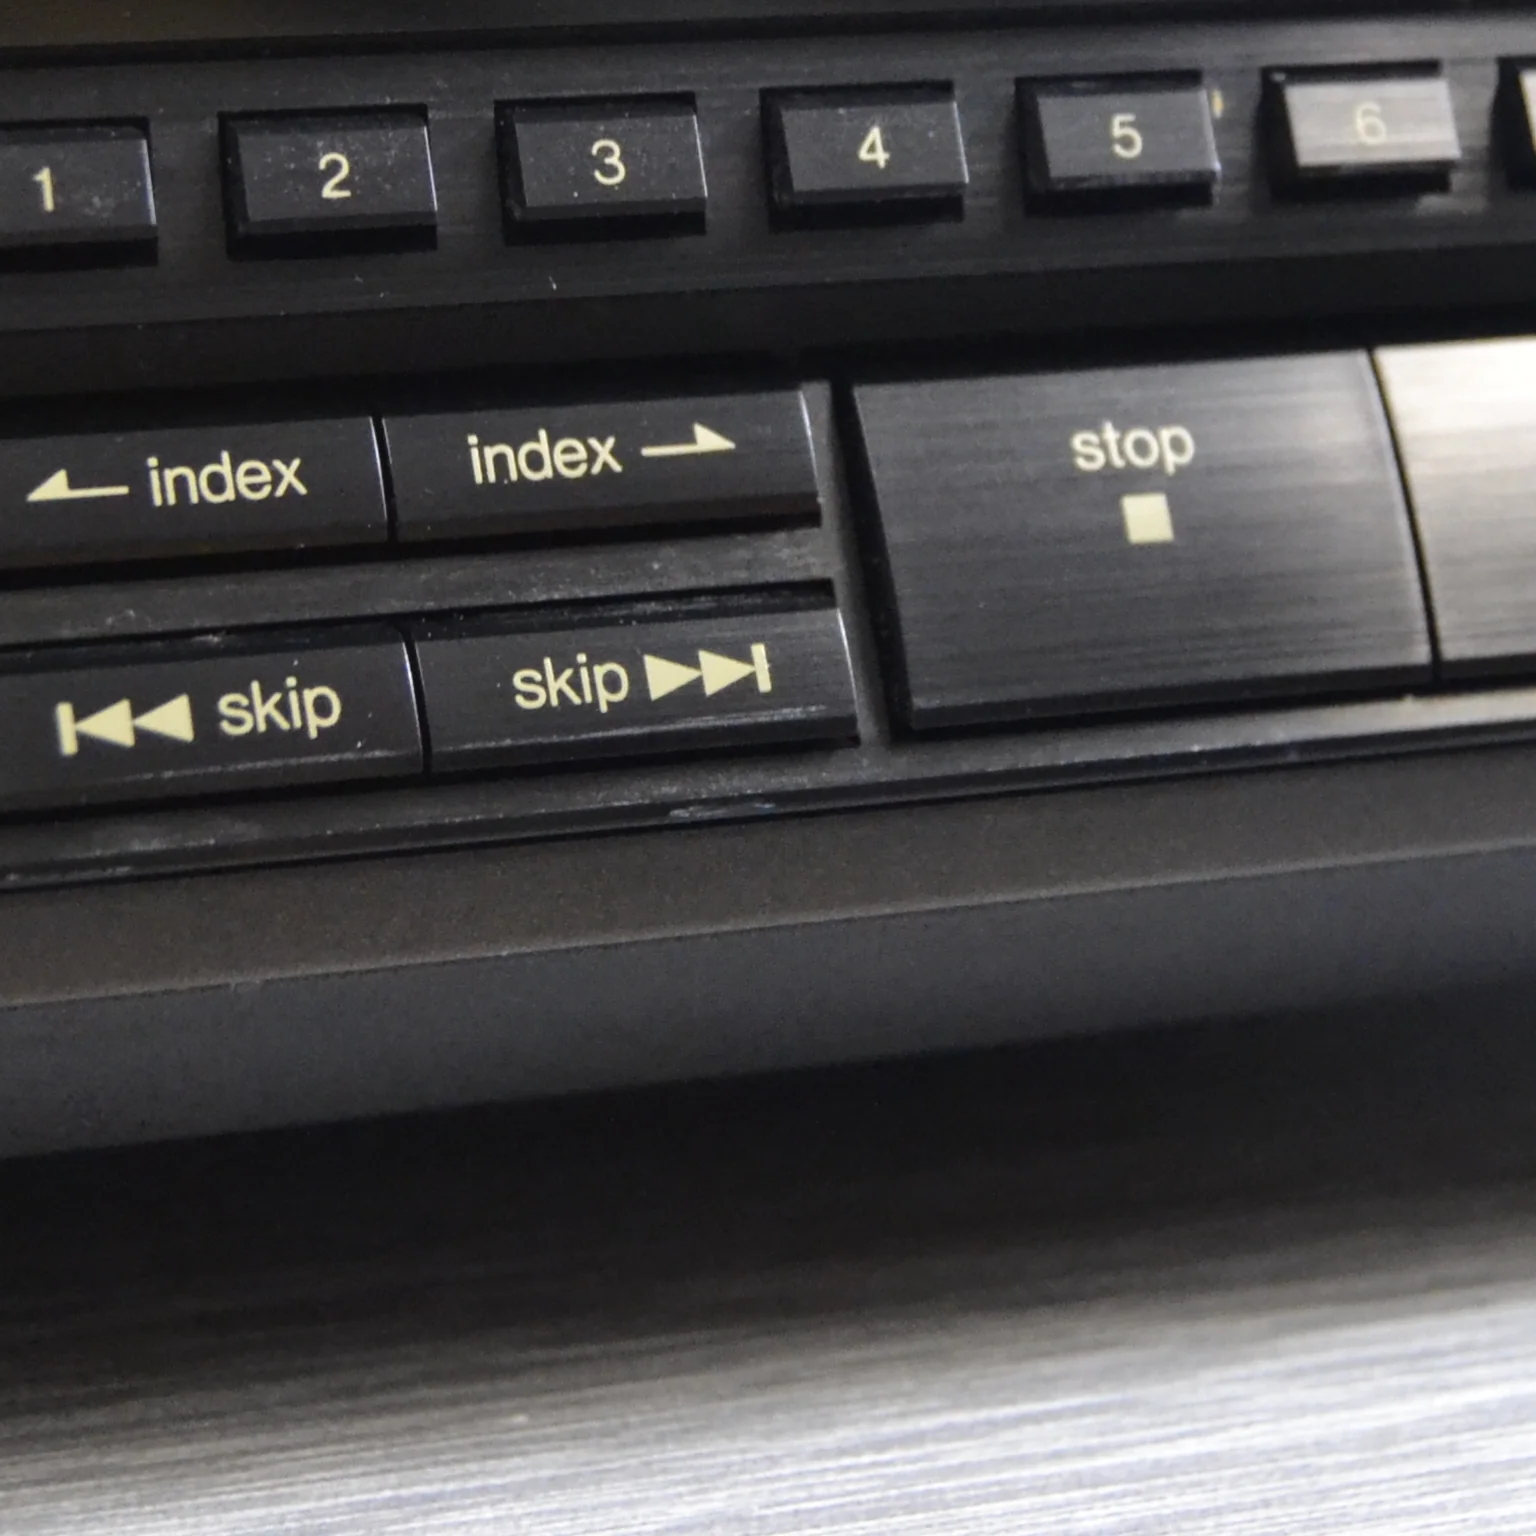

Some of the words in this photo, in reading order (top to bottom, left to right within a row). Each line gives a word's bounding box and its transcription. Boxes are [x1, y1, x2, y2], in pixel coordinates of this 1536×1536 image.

[857, 124, 890, 169] 4
[1110, 113, 1144, 159] 5
[1352, 98, 1388, 148] 6
[318, 151, 352, 200] 2
[590, 138, 627, 186] 3
[33, 166, 55, 212] 1
[466, 428, 623, 485] index
[1070, 420, 1197, 475] stop
[146, 450, 308, 507] index
[512, 651, 630, 713] skip
[217, 675, 342, 740] skip
